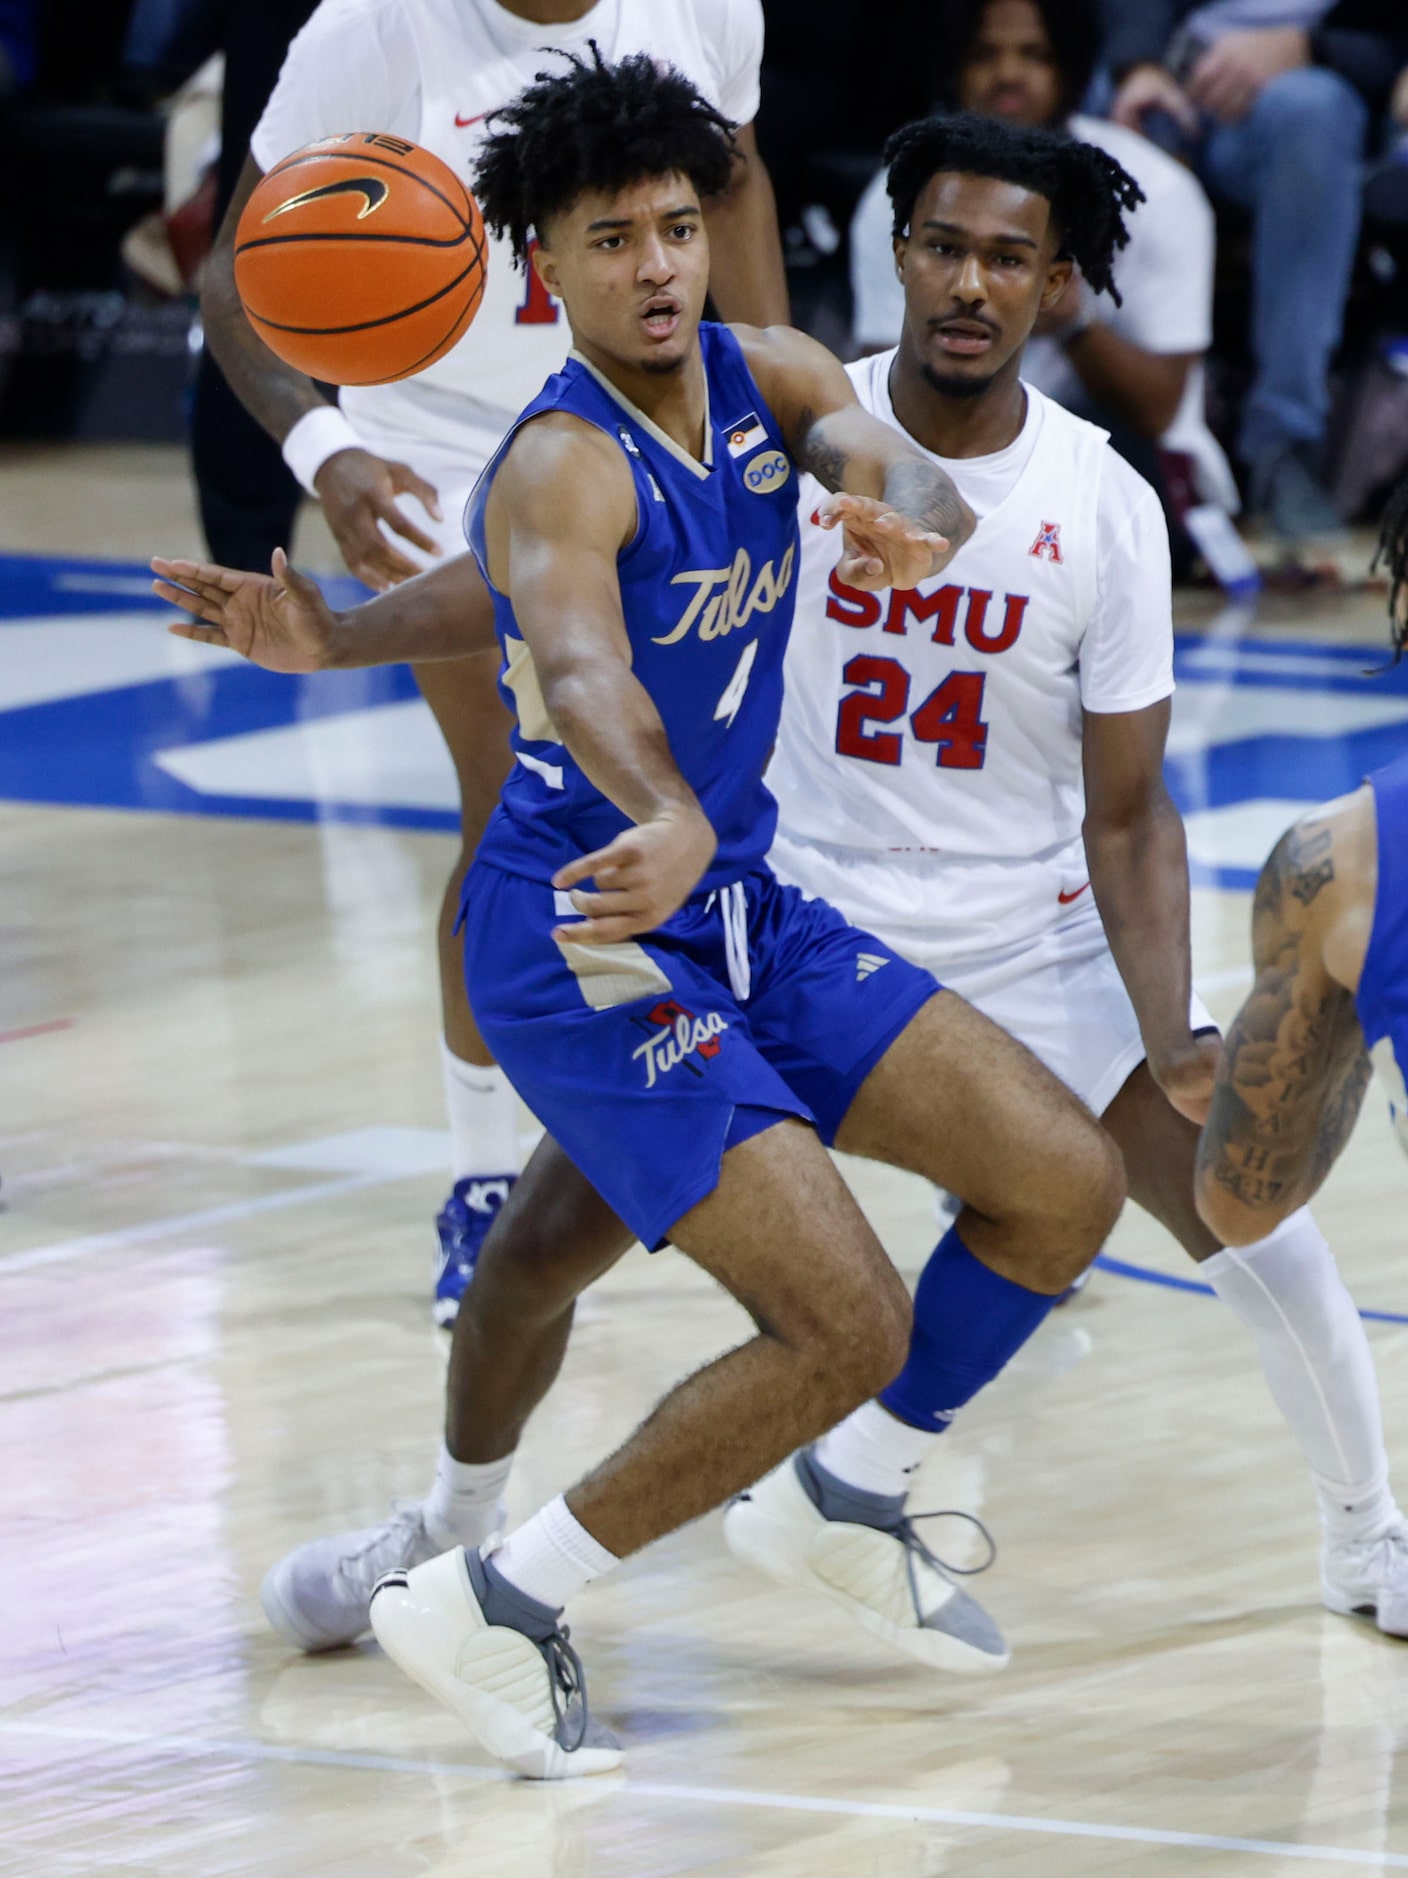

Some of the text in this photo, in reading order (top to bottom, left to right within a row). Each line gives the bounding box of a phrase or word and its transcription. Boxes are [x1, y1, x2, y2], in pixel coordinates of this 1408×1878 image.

[747, 456, 787, 488] DOC
[650, 541, 796, 646] Tulsa
[825, 567, 1030, 655] SMU
[713, 637, 759, 729] 4
[835, 652, 990, 770] 24
[631, 1011, 729, 1089] Tulsa
